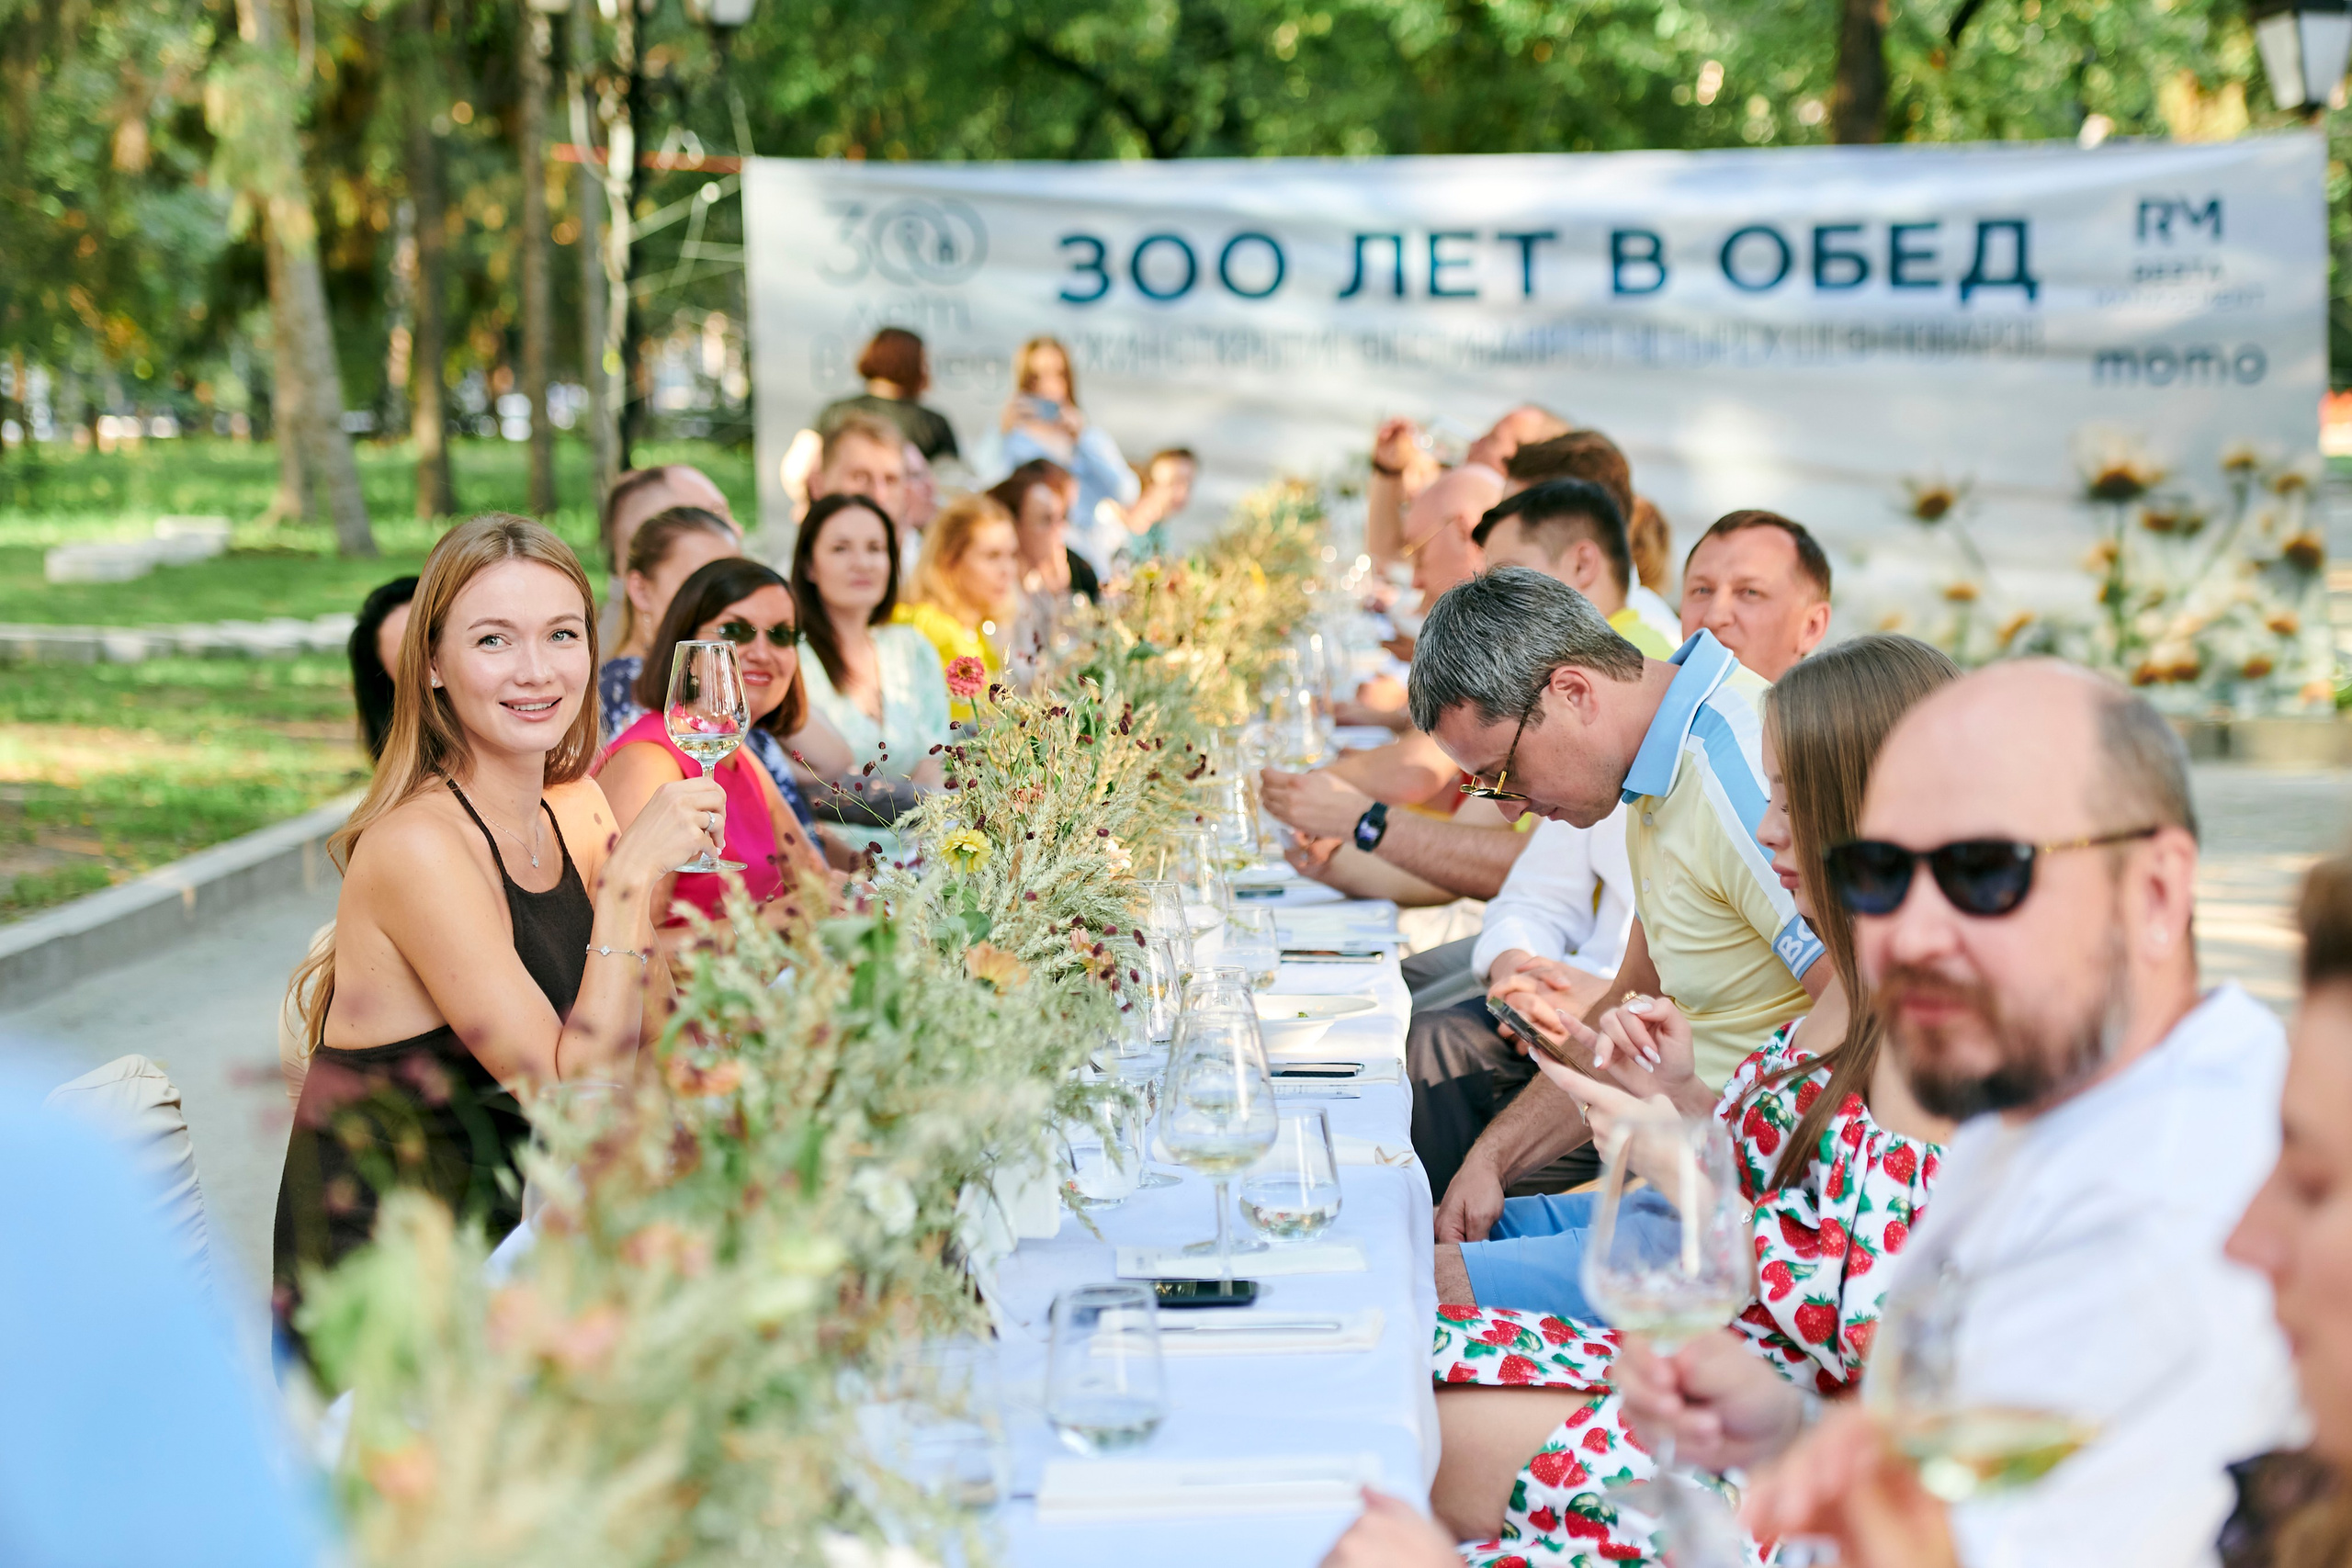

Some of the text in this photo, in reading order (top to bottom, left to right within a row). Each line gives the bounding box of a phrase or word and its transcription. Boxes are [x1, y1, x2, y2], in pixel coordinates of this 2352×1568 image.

[2135, 196, 2224, 243] RM
[1057, 215, 2041, 308] 300 ЛЕТ В ОБЕД
[2092, 344, 2268, 387] momo
